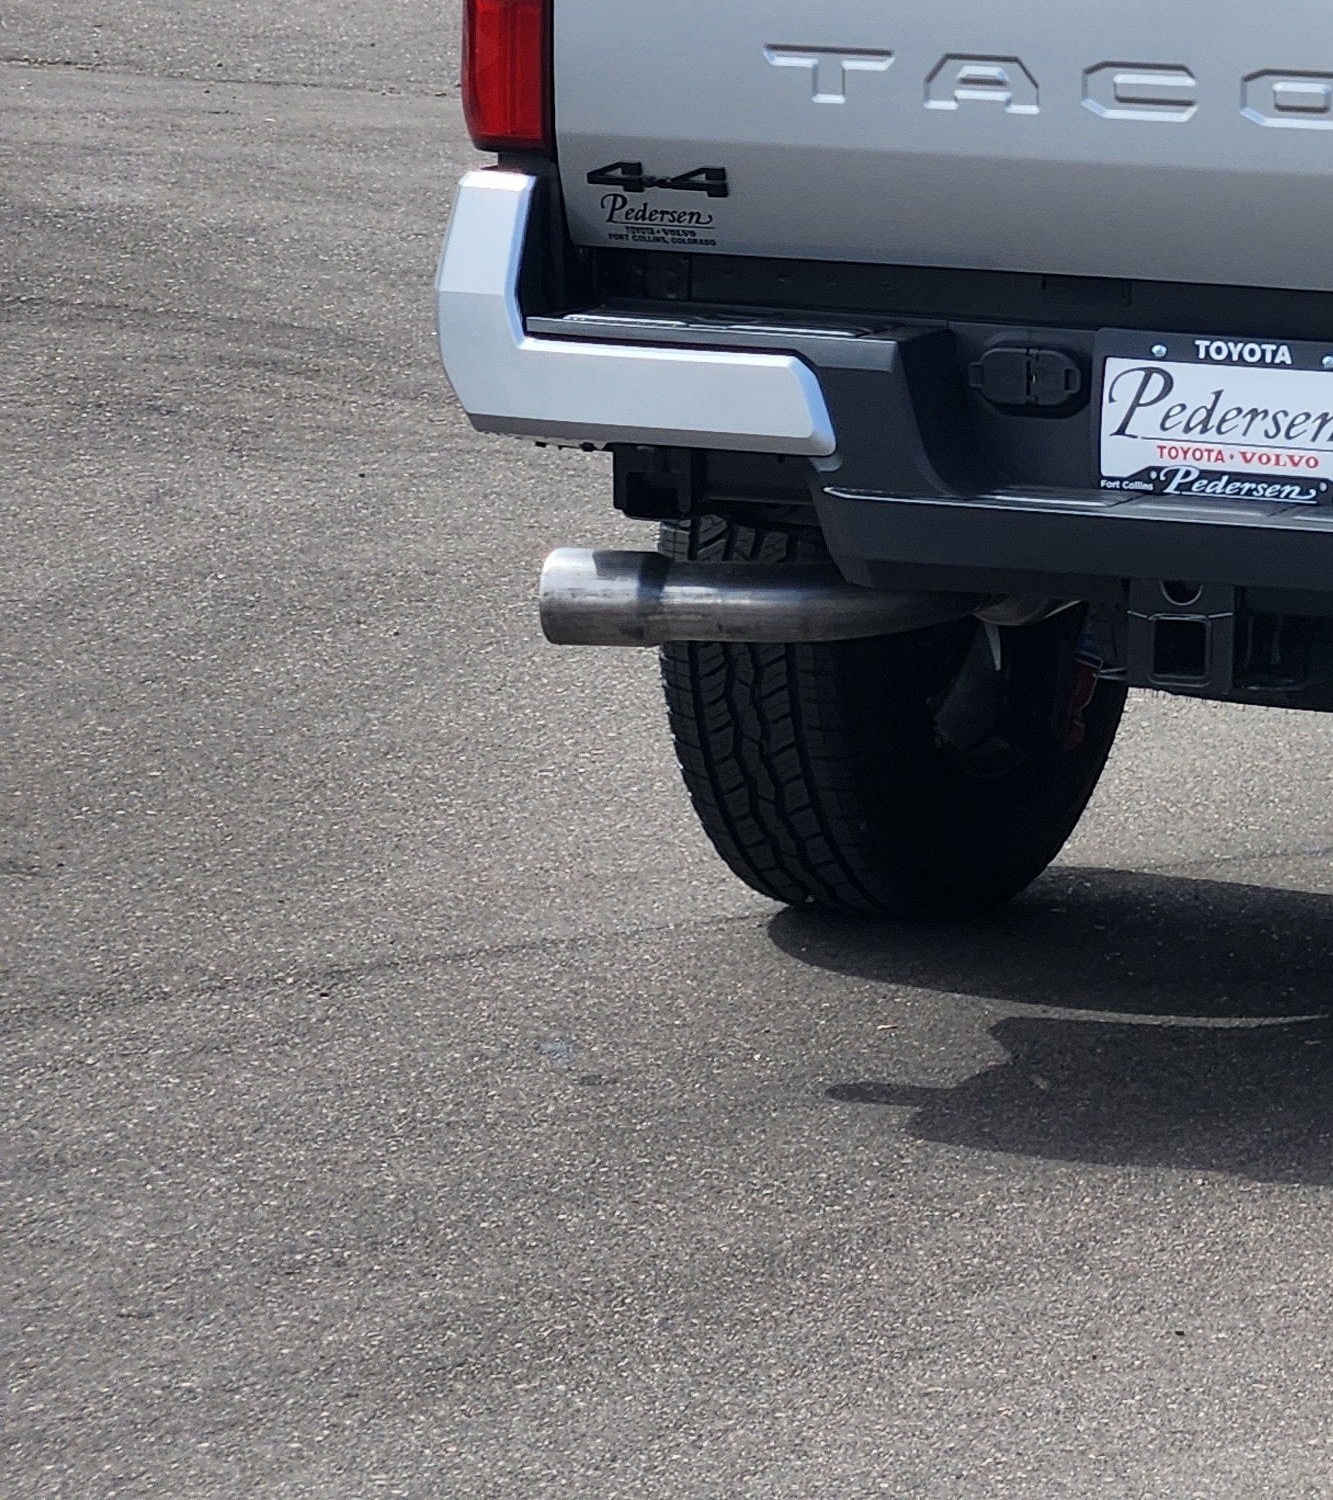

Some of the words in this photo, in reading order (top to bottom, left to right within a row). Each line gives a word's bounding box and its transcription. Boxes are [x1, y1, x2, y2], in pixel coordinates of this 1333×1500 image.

[600, 193, 714, 226] Pedersen
[1194, 340, 1293, 365] TOYOTA
[1157, 445, 1226, 464] TOYOTA
[1239, 452, 1320, 468] VOLVO
[1100, 479, 1120, 490] Fort
[1121, 480, 1154, 491] Collins
[1160, 465, 1318, 501] Pedersen
